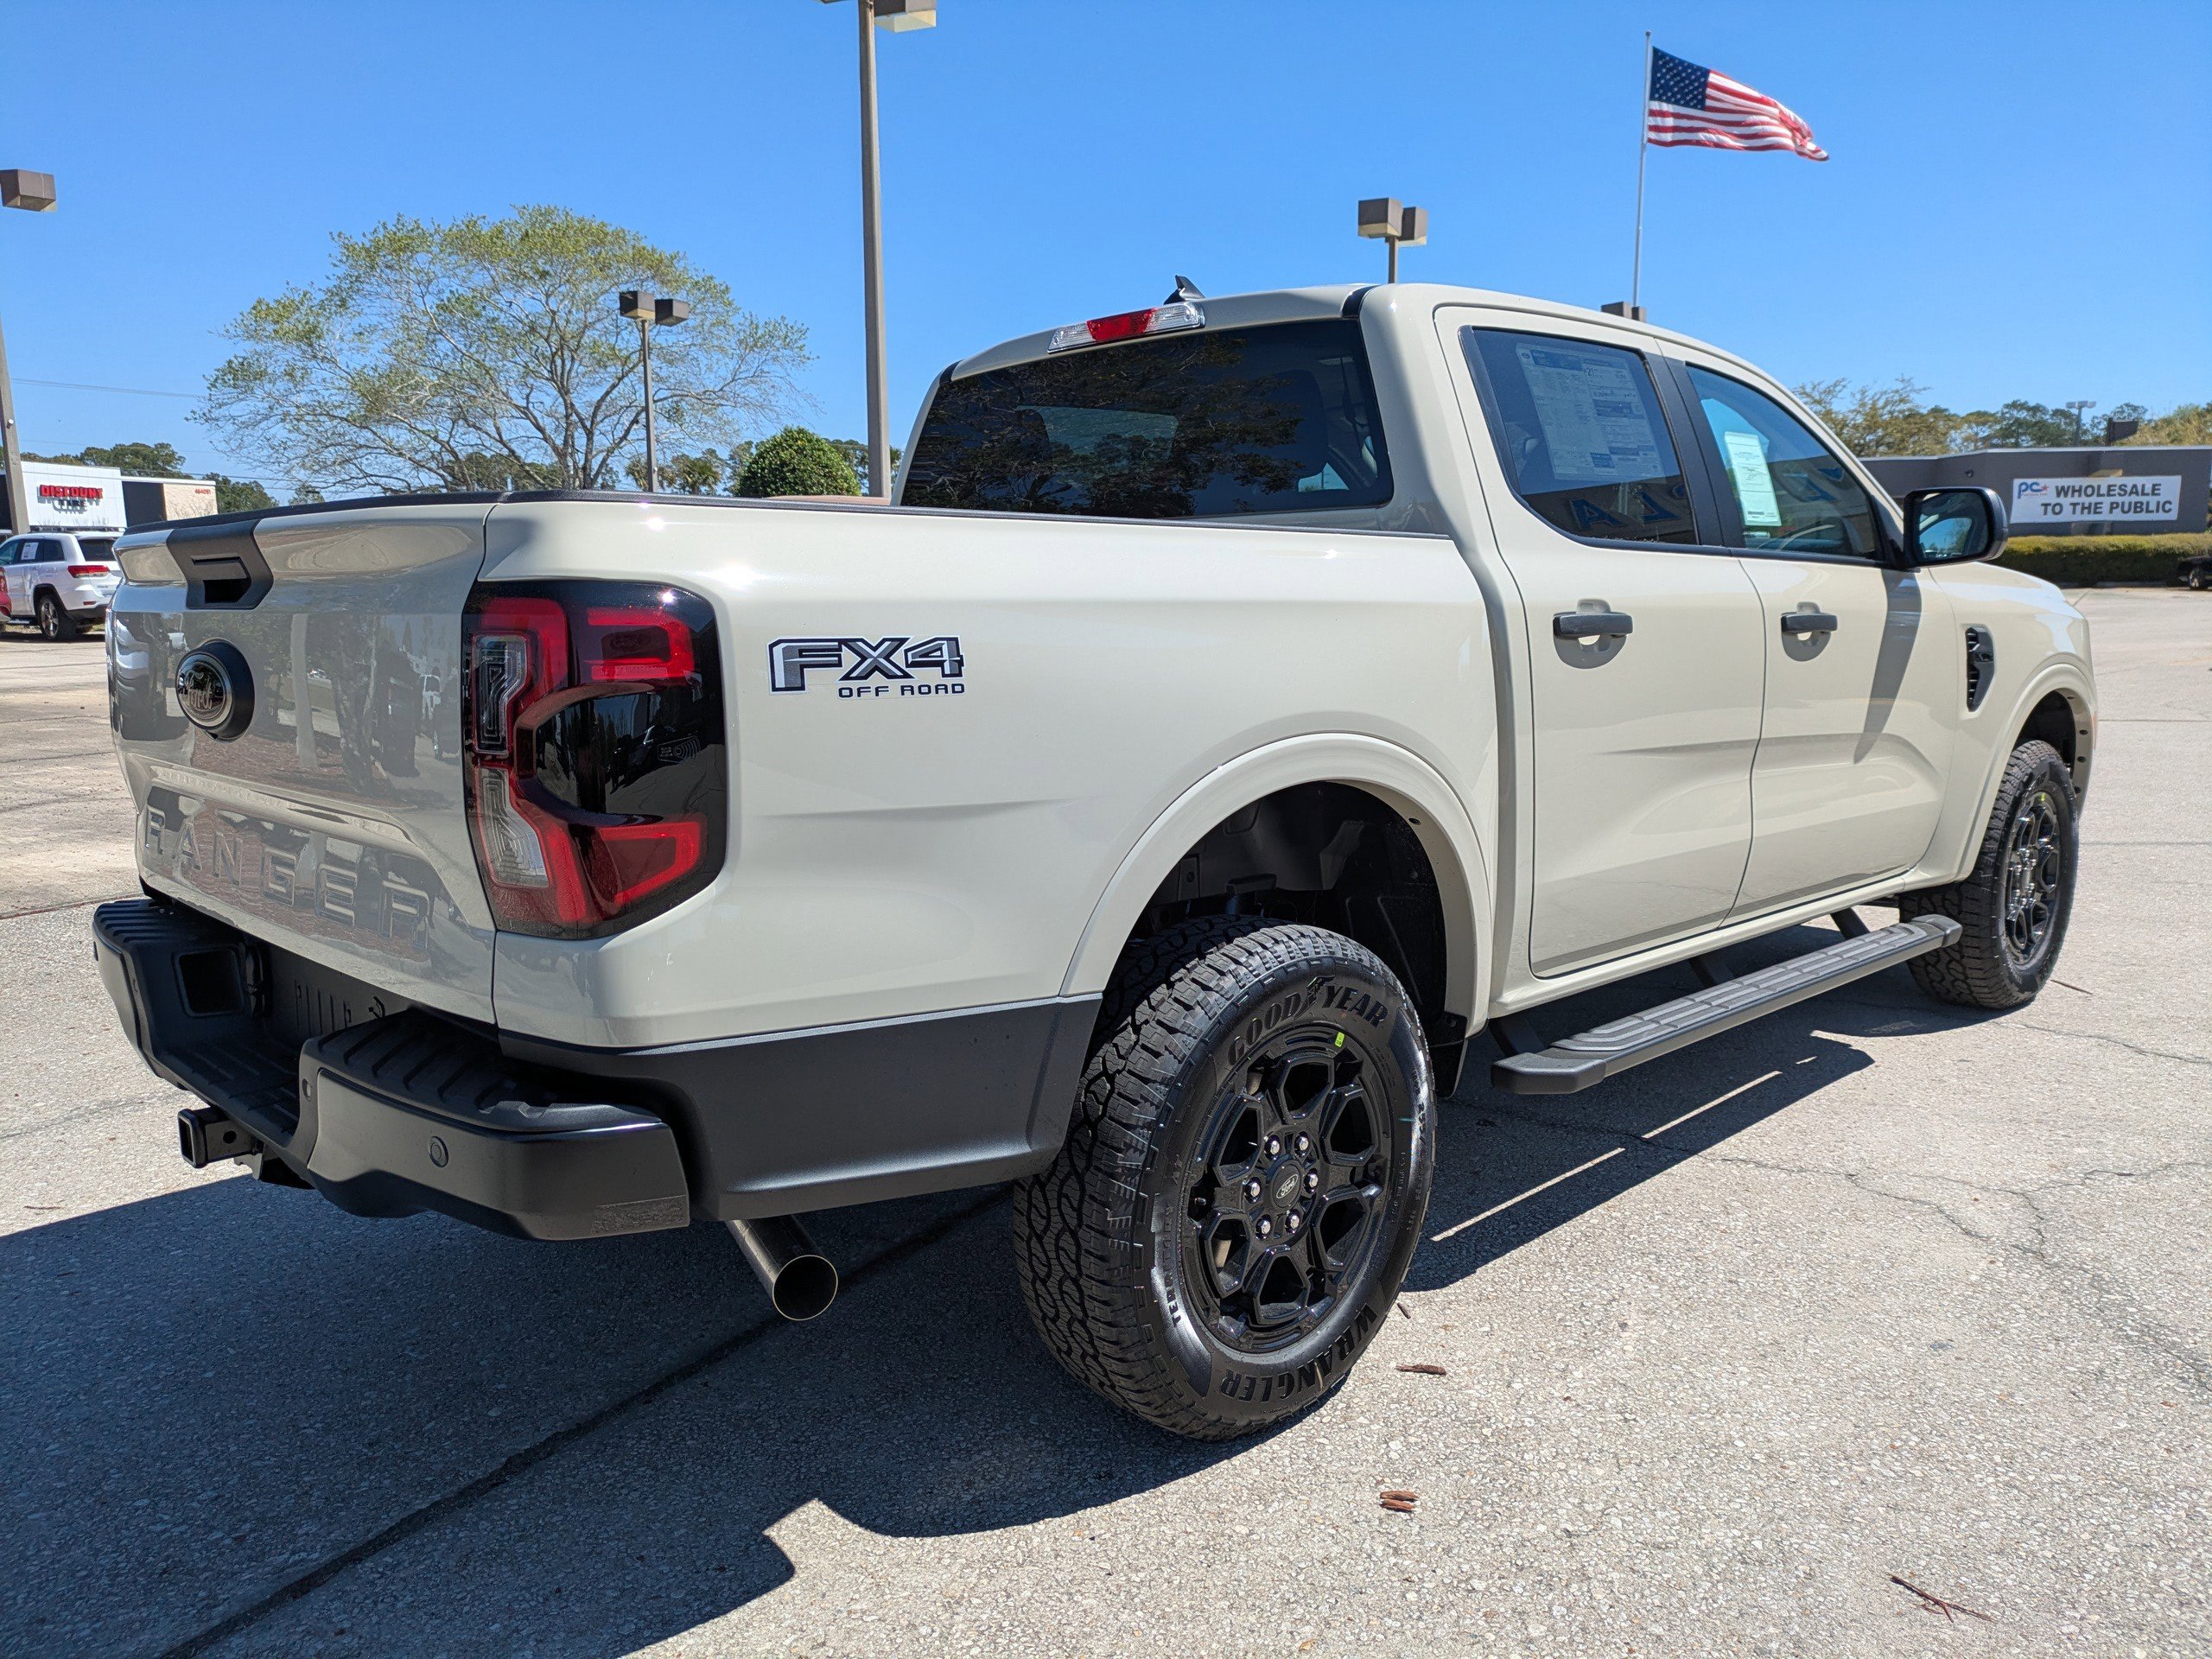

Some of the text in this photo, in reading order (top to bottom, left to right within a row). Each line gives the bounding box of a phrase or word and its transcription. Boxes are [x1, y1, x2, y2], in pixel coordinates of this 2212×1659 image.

[40, 485, 103, 499] DISCOUNT
[2056, 484, 2161, 498] WHOLESALE
[59, 499, 87, 508] TIRE
[2041, 500, 2173, 516] TO THE PUBLIC
[767, 636, 964, 692] FX4
[838, 683, 965, 698] OFF ROAD
[145, 804, 429, 950] RANGER
[1227, 976, 1389, 1066] GOODYEAR
[1281, 1178, 1296, 1197] Ford
[1221, 1303, 1378, 1402] WRANGLER
